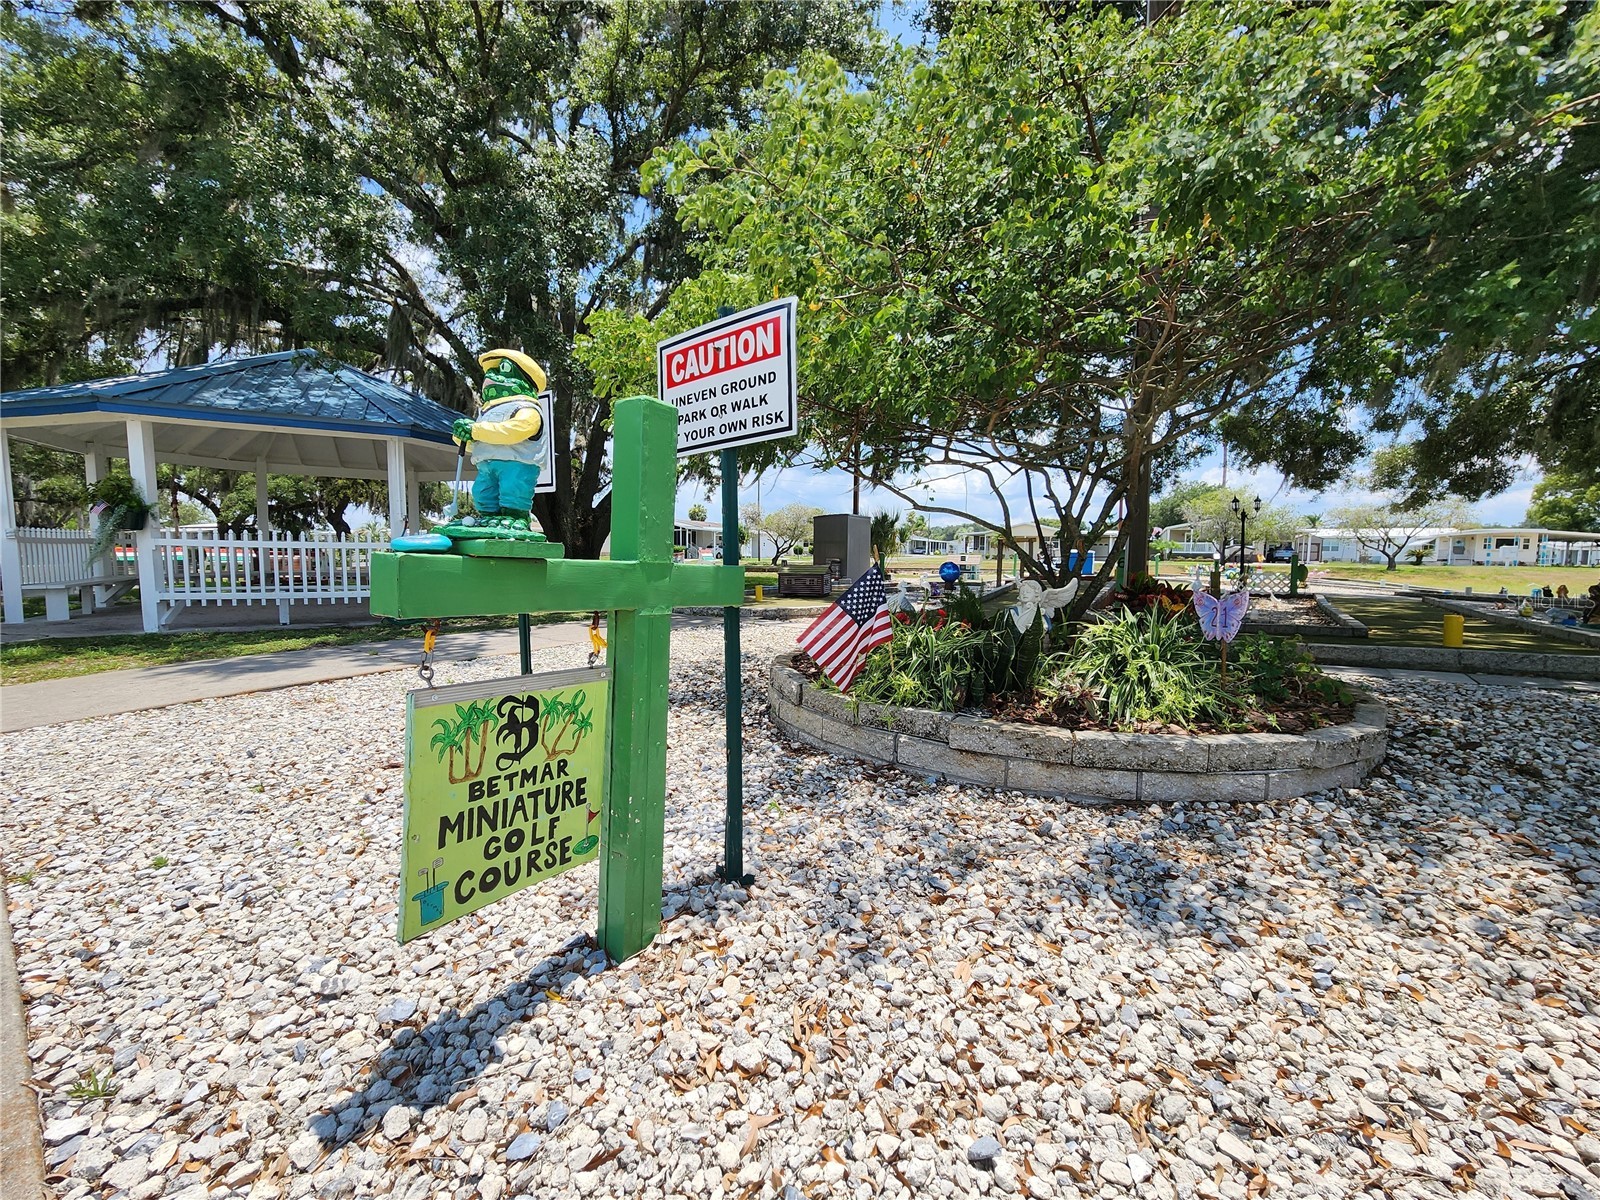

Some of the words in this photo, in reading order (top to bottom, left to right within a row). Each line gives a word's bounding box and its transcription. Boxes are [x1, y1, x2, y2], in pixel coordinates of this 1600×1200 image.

[671, 322, 775, 383] CAUTION
[671, 387, 717, 407] UNEVEN
[721, 371, 777, 395] GROUND
[678, 408, 707, 426] PARK
[711, 404, 727, 417] OR
[731, 393, 768, 412] WALK
[684, 426, 715, 442] YOUR
[719, 419, 747, 435] OWN
[752, 410, 784, 428] RISK
[1211, 606, 1228, 628] 21
[496, 694, 540, 771] B
[468, 758, 569, 803] BETMAR
[438, 777, 587, 850] MINIATURE
[483, 816, 560, 860] GOLF
[454, 835, 573, 904] COURSE
